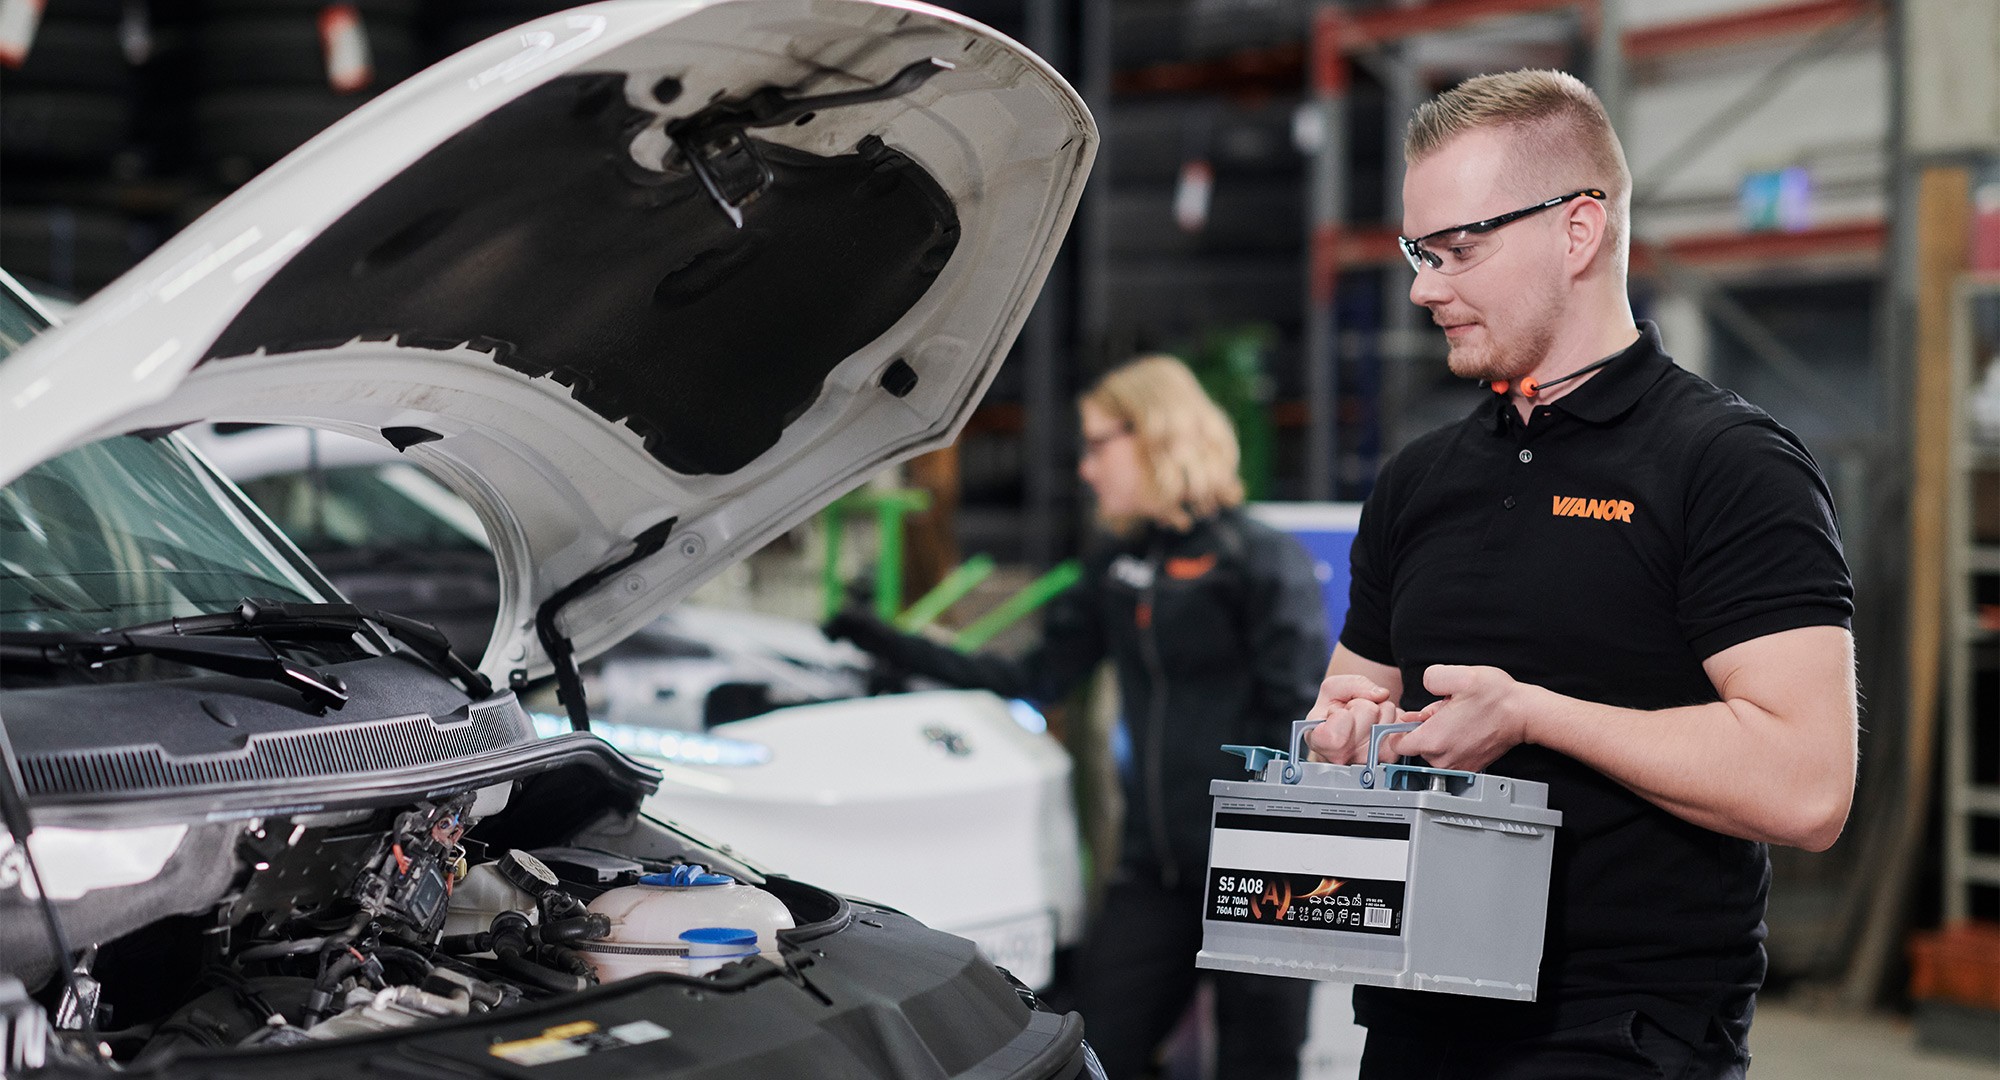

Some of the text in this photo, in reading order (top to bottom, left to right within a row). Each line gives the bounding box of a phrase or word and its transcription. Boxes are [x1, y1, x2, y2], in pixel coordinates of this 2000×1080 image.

[1552, 495, 1635, 523] VIANOR
[1218, 876, 1264, 894] S5 A08
[1217, 895, 1248, 905] 12V 70Ah
[1216, 906, 1248, 917] 760A (EN)
